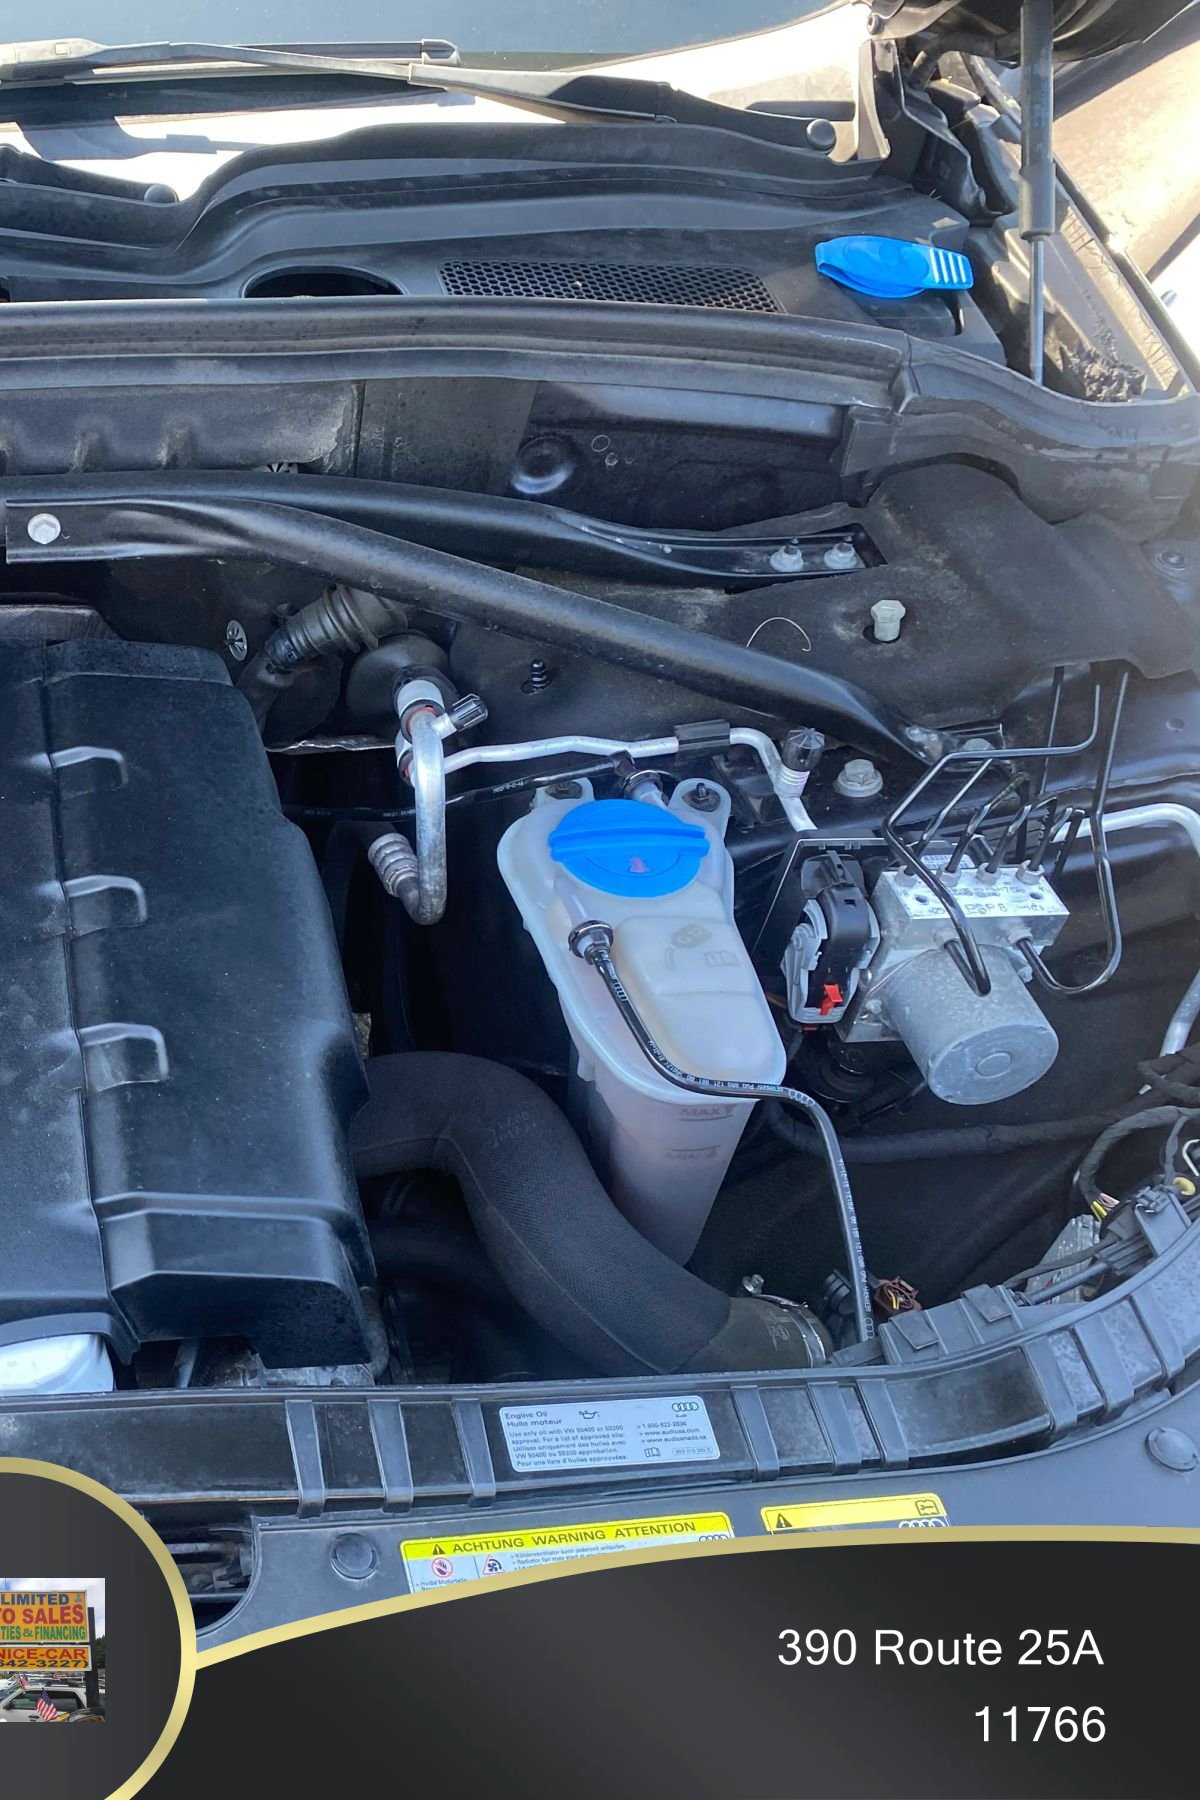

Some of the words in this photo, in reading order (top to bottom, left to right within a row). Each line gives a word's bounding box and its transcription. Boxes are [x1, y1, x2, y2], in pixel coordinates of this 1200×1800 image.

[505, 1412, 533, 1421] Engine
[580, 1433, 610, 1441] approved
[537, 1443, 576, 1451] uniquement
[453, 1538, 525, 1553] ACHTUNG
[531, 1529, 606, 1545] WARNING
[615, 1521, 696, 1538] ATTENTION
